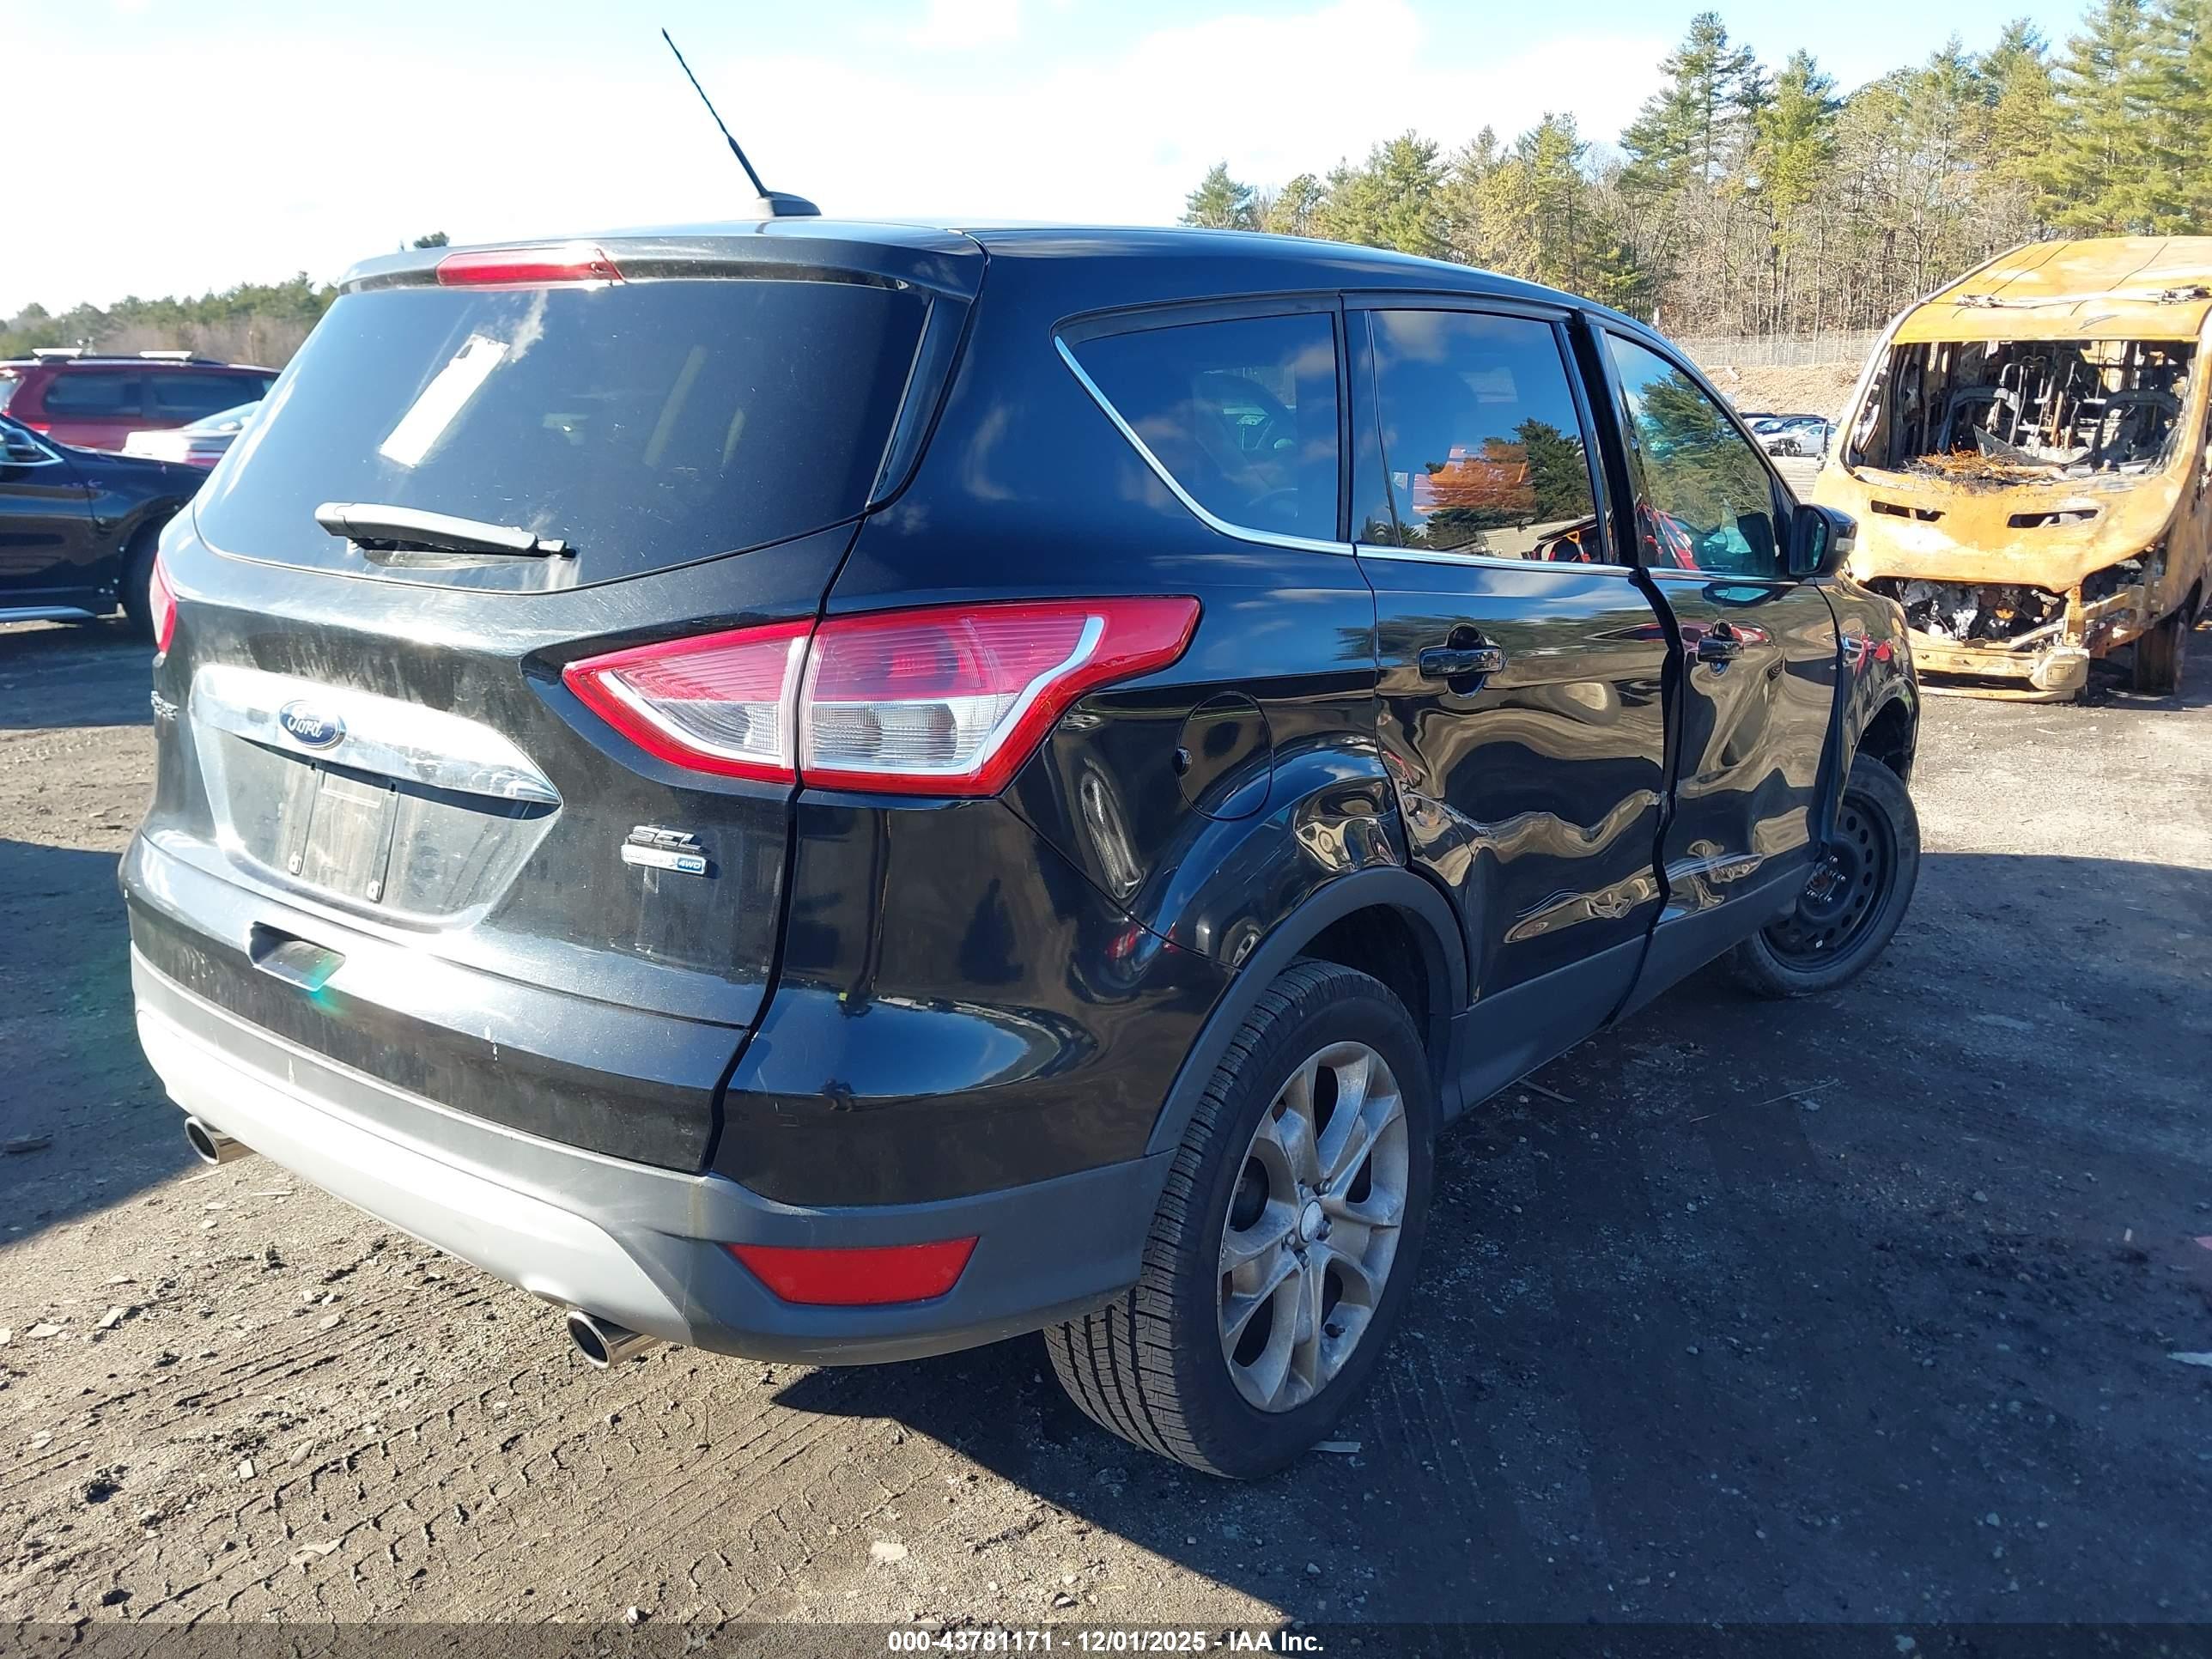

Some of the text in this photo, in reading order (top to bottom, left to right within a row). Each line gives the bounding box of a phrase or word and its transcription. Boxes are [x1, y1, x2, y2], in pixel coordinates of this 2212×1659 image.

[286, 705, 325, 738] Ford
[628, 824, 702, 850] SEL
[678, 859, 702, 870] 4WD
